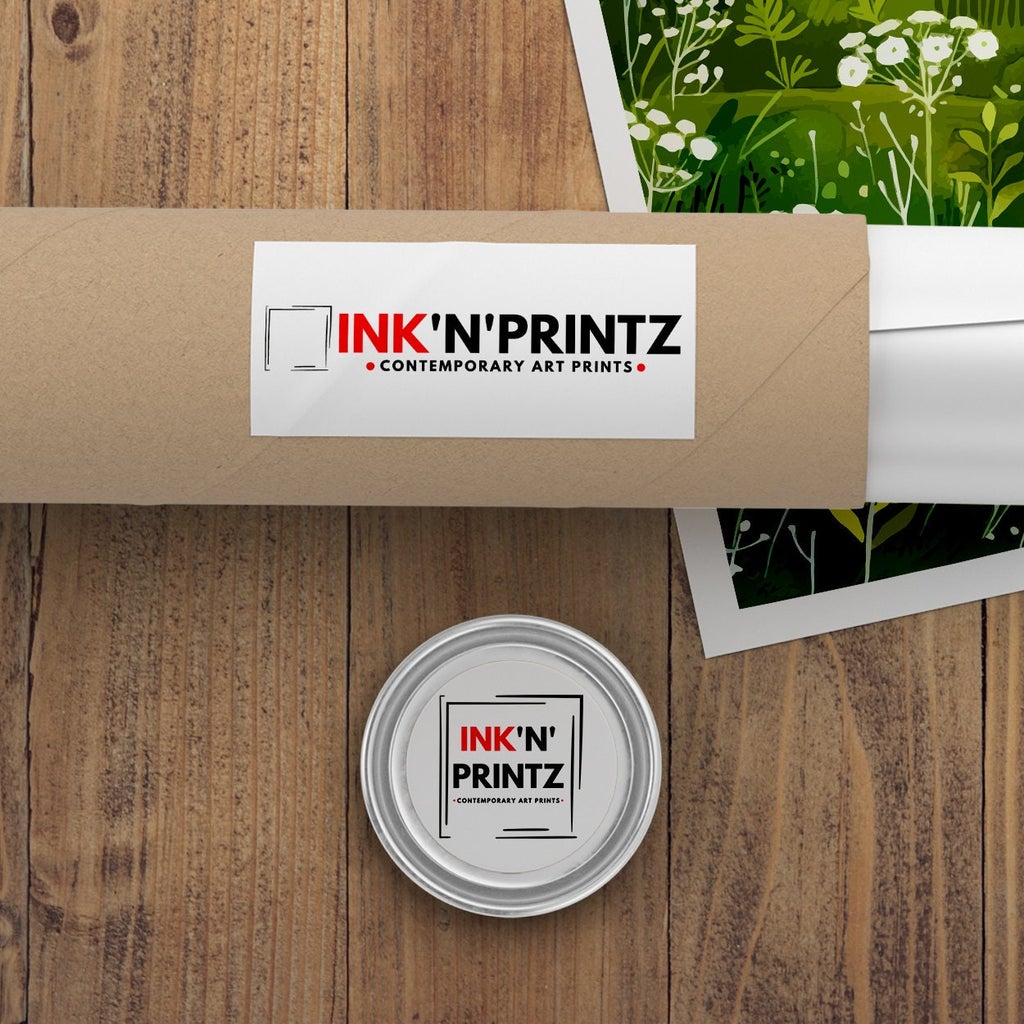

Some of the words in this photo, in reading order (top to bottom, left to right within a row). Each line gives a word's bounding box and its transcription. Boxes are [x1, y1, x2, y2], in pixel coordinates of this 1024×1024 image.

[338, 313, 682, 355] INK'N'PRINTZ
[380, 359, 523, 373] CONTEMPORARY
[532, 360, 564, 373] ART
[572, 360, 633, 374] PRINTS
[460, 726, 555, 751] INK'N'
[453, 763, 564, 789] PRINTZ
